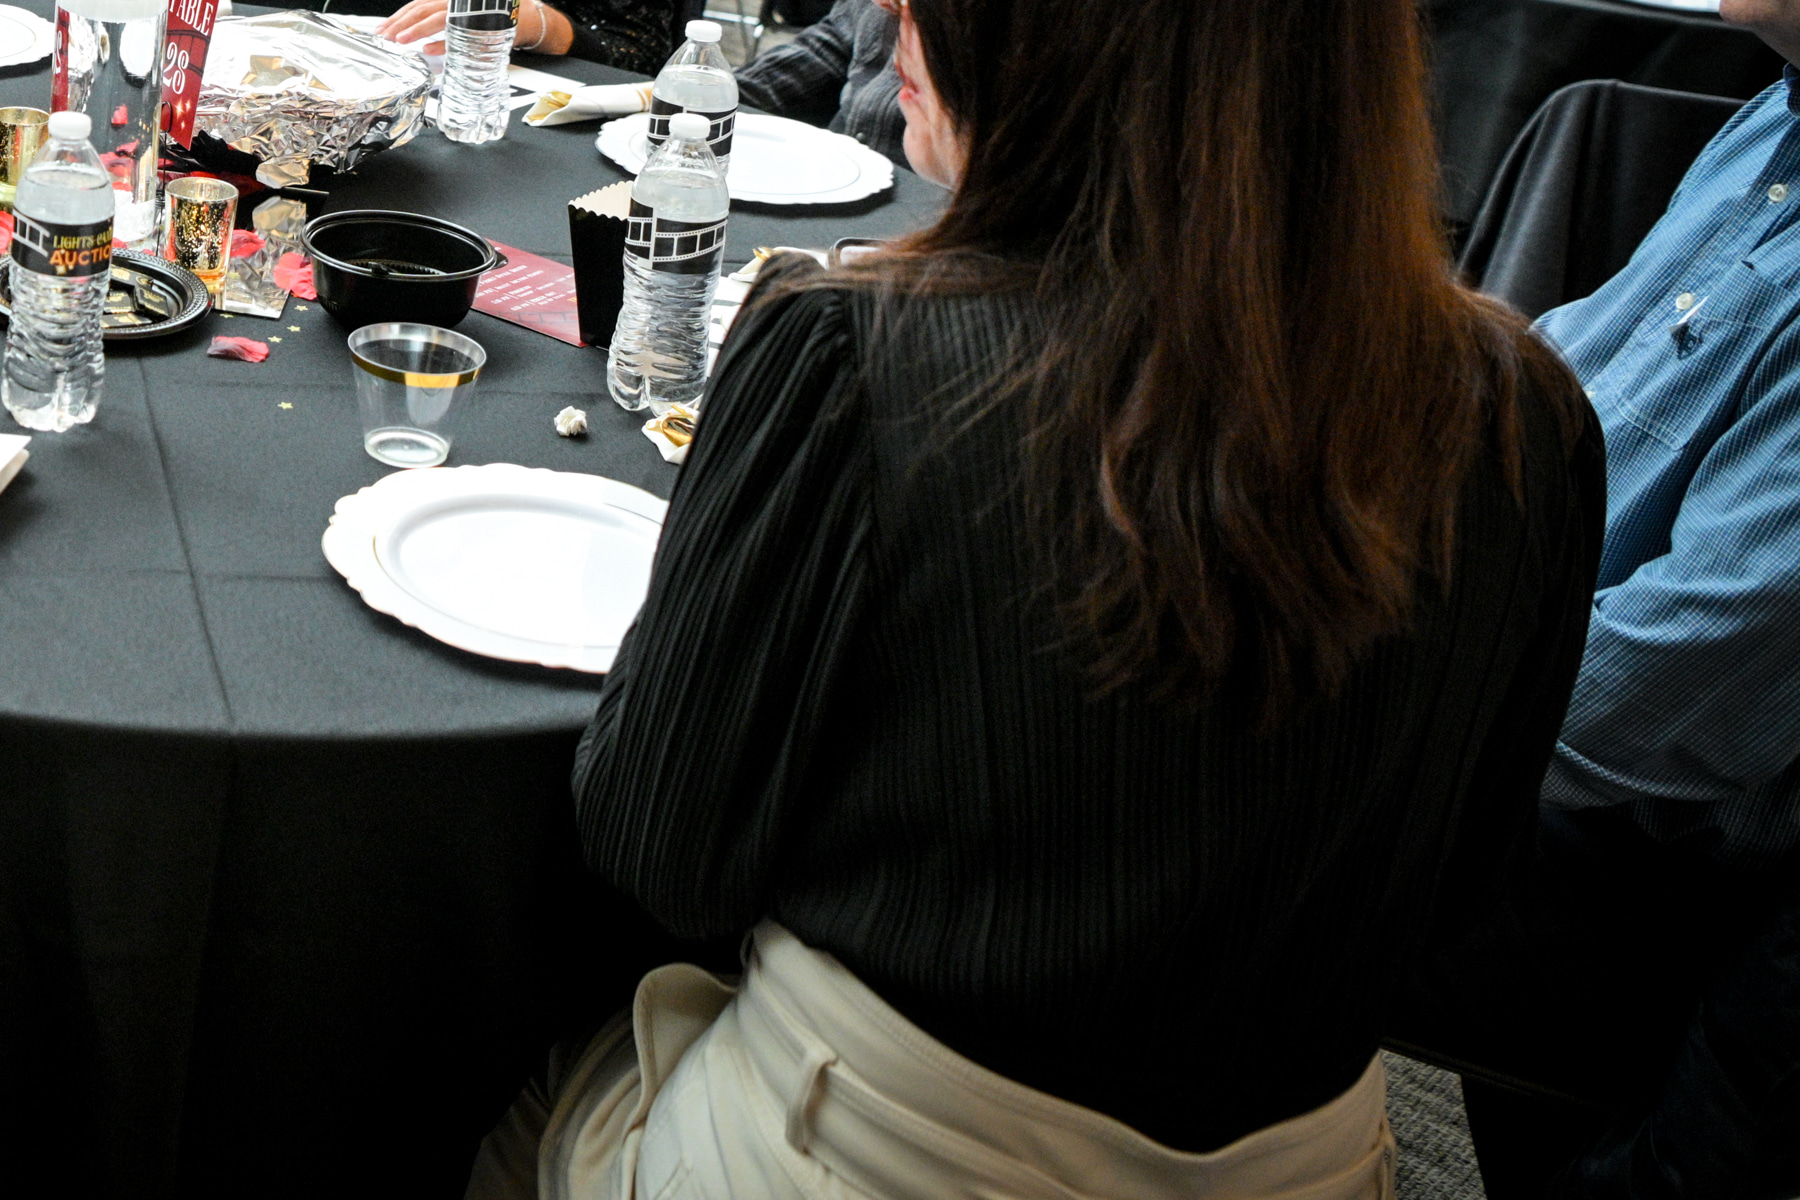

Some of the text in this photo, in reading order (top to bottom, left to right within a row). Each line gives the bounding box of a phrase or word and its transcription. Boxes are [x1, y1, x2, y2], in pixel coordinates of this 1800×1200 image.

[162, 42, 189, 95] 28
[53, 234, 94, 249] LIGHTS
[49, 244, 112, 266] AUCTIO
